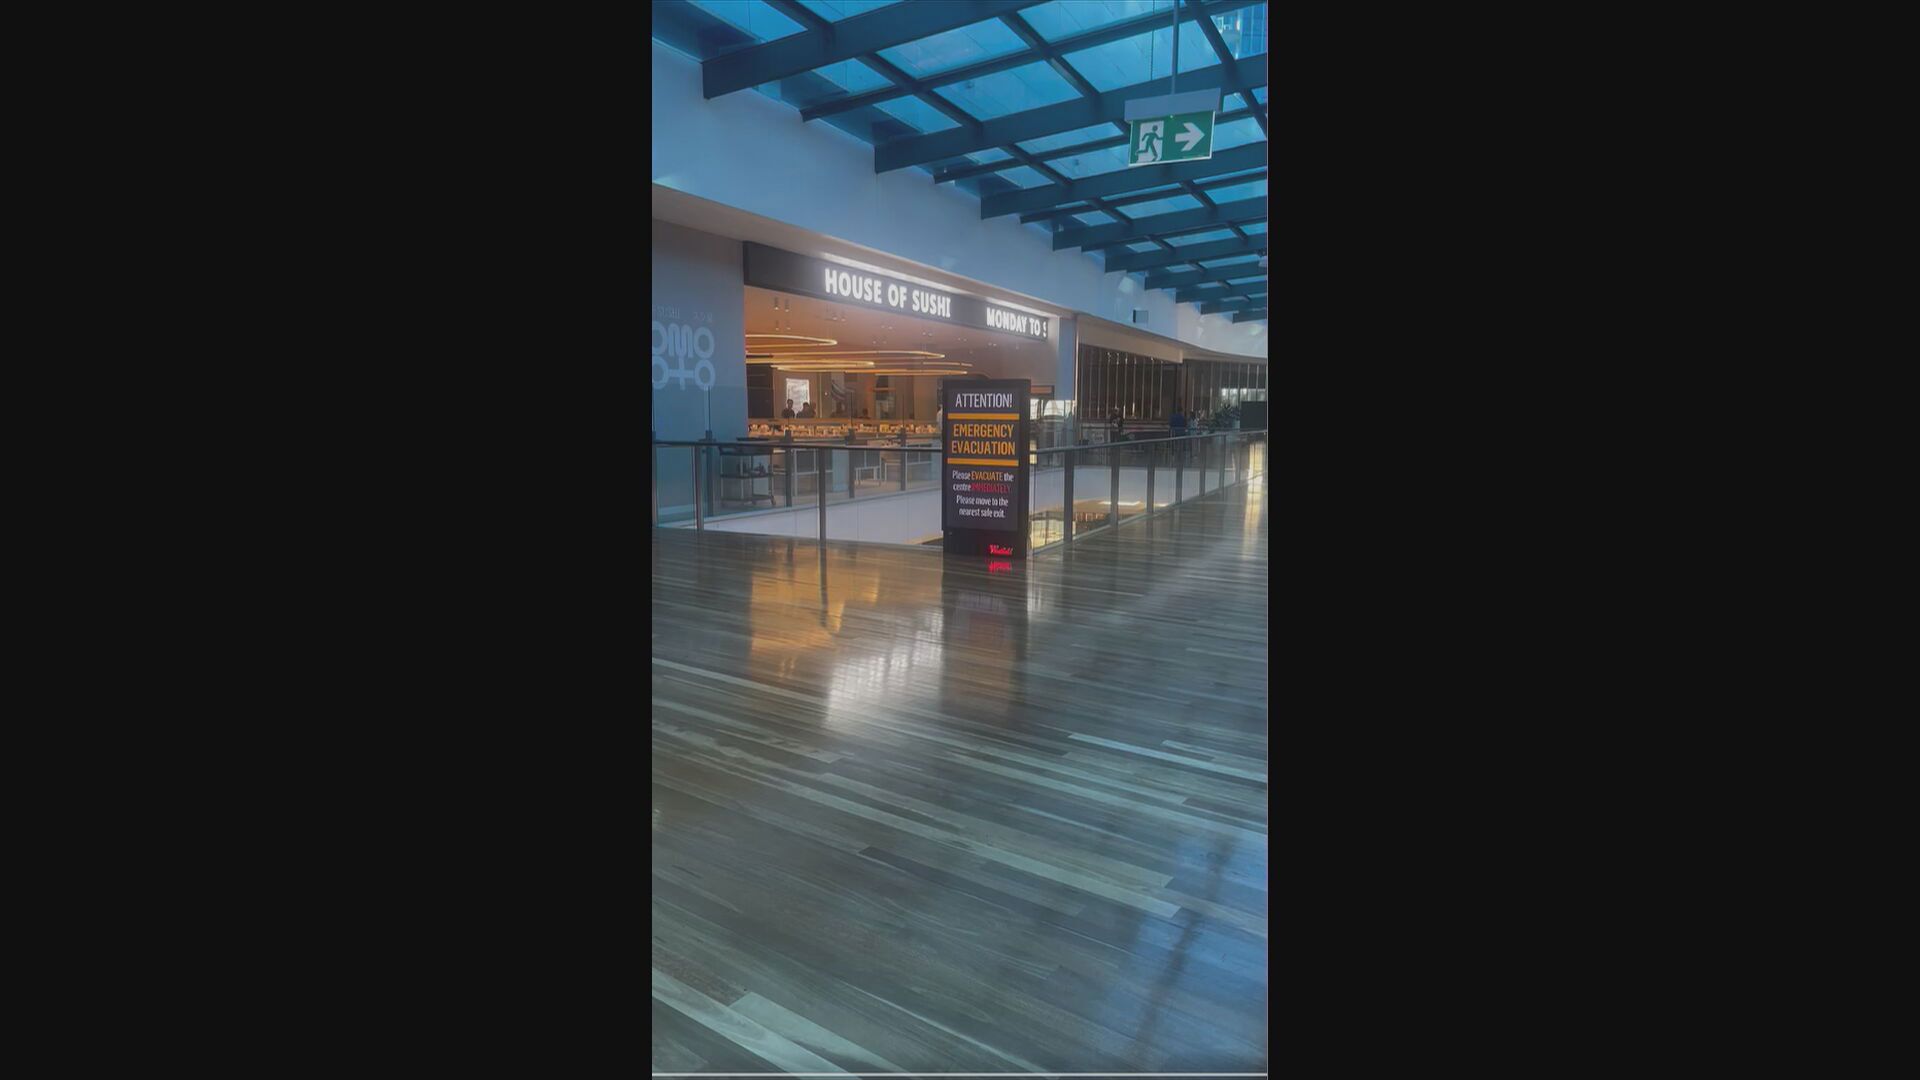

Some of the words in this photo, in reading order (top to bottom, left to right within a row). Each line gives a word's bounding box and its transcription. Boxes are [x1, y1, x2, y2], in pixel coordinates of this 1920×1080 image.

[825, 268, 882, 304] HOUSE
[888, 284, 907, 308] OF
[912, 290, 951, 318] SUSHI
[987, 307, 1027, 333] MONDAY
[1029, 318, 1041, 336] TO
[955, 393, 1013, 409] ATTENTION!
[953, 424, 1014, 438] EMERGENCY
[951, 441, 1016, 456] EVACUATION
[952, 470, 971, 480] Please
[971, 471, 1003, 482] EVACUATE
[1004, 472, 1014, 481] the
[953, 483, 971, 491] centre
[956, 495, 975, 505] Please
[975, 497, 991, 506] move
[992, 498, 998, 506] to
[999, 498, 1008, 507] the
[959, 508, 980, 517] nearest
[981, 508, 993, 517] safe
